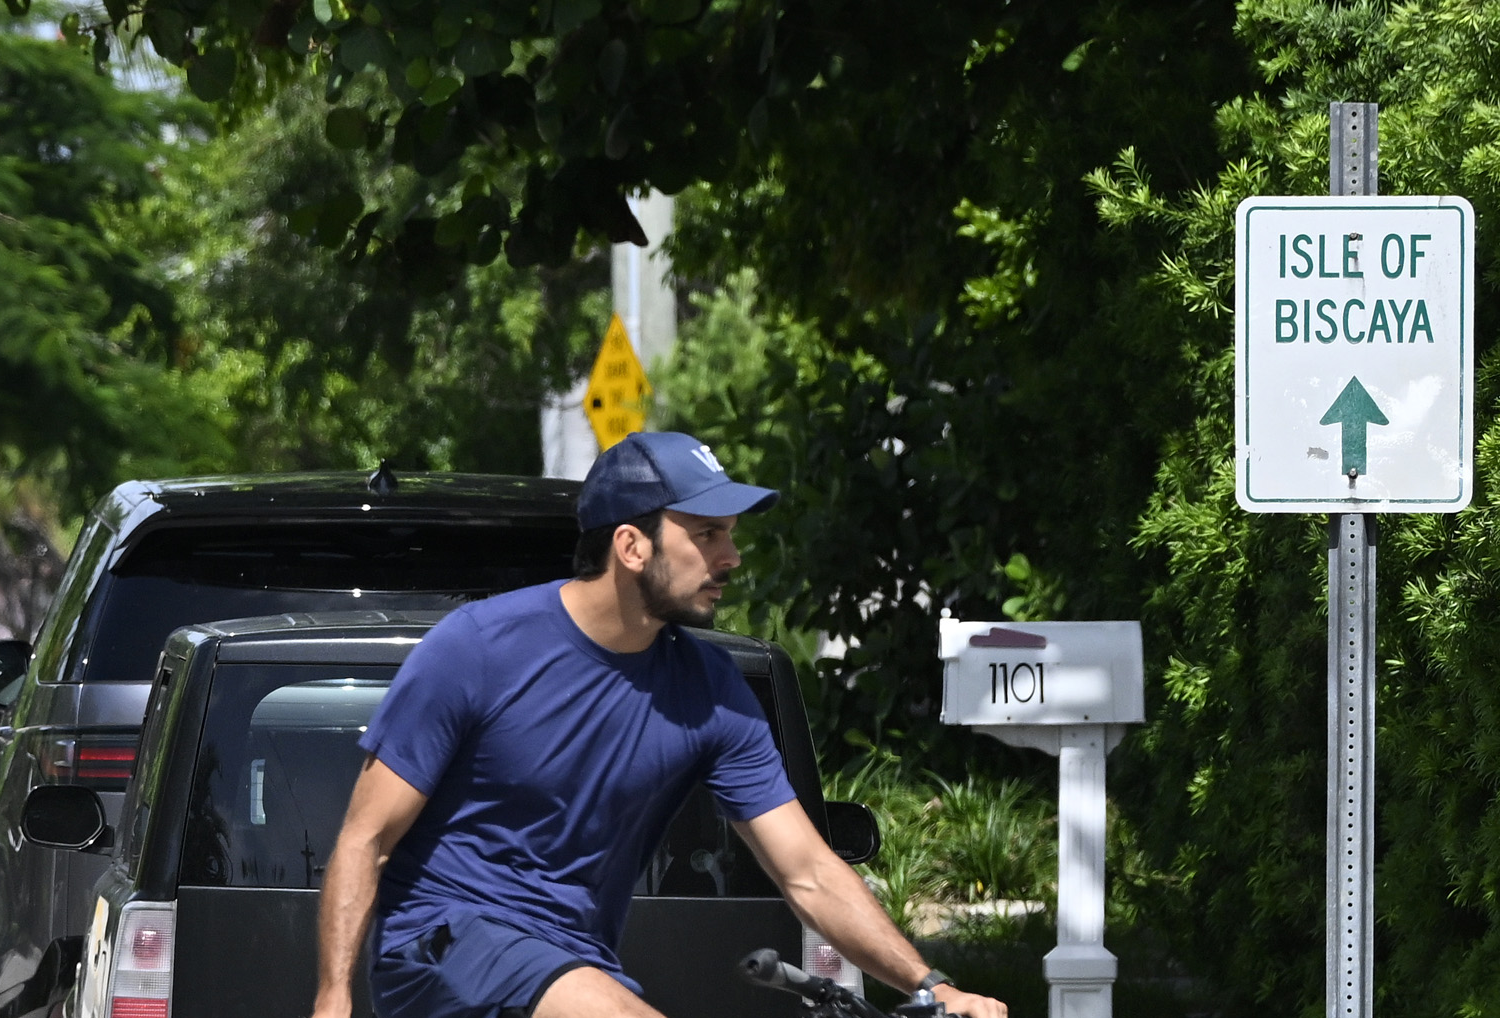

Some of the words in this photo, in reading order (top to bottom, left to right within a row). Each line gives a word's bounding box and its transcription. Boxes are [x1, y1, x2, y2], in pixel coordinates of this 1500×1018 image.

[1279, 234, 1363, 278] ISLE
[1381, 234, 1432, 278] OF
[1275, 299, 1434, 344] BISCAYA
[989, 662, 1044, 704] 1101
